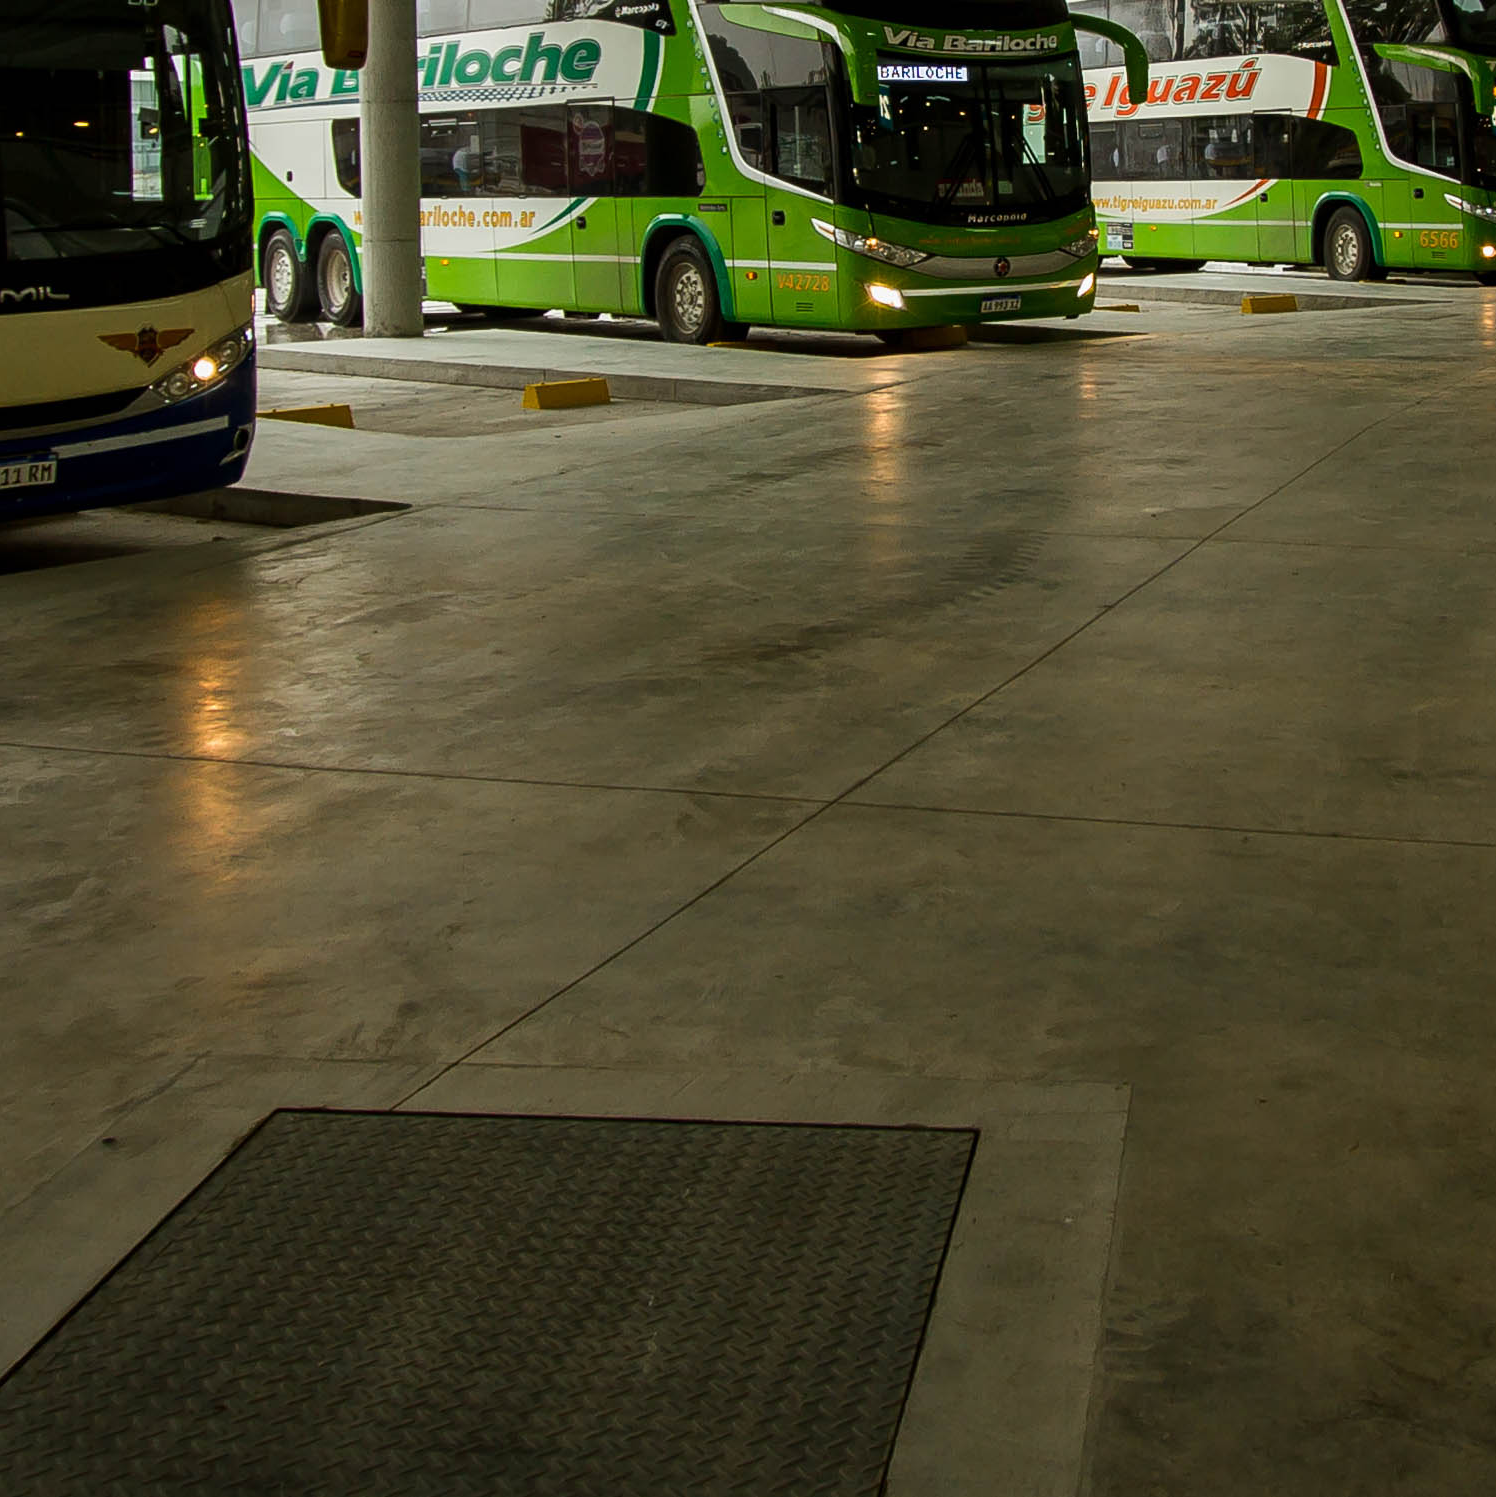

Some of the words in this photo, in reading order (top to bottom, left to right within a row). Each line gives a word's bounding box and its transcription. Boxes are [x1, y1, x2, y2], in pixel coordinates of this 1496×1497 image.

[883, 26, 935, 49] Via
[943, 34, 1058, 53] Bariloche
[879, 66, 965, 81] BARILOCHE
[1419, 230, 1460, 249] 6566
